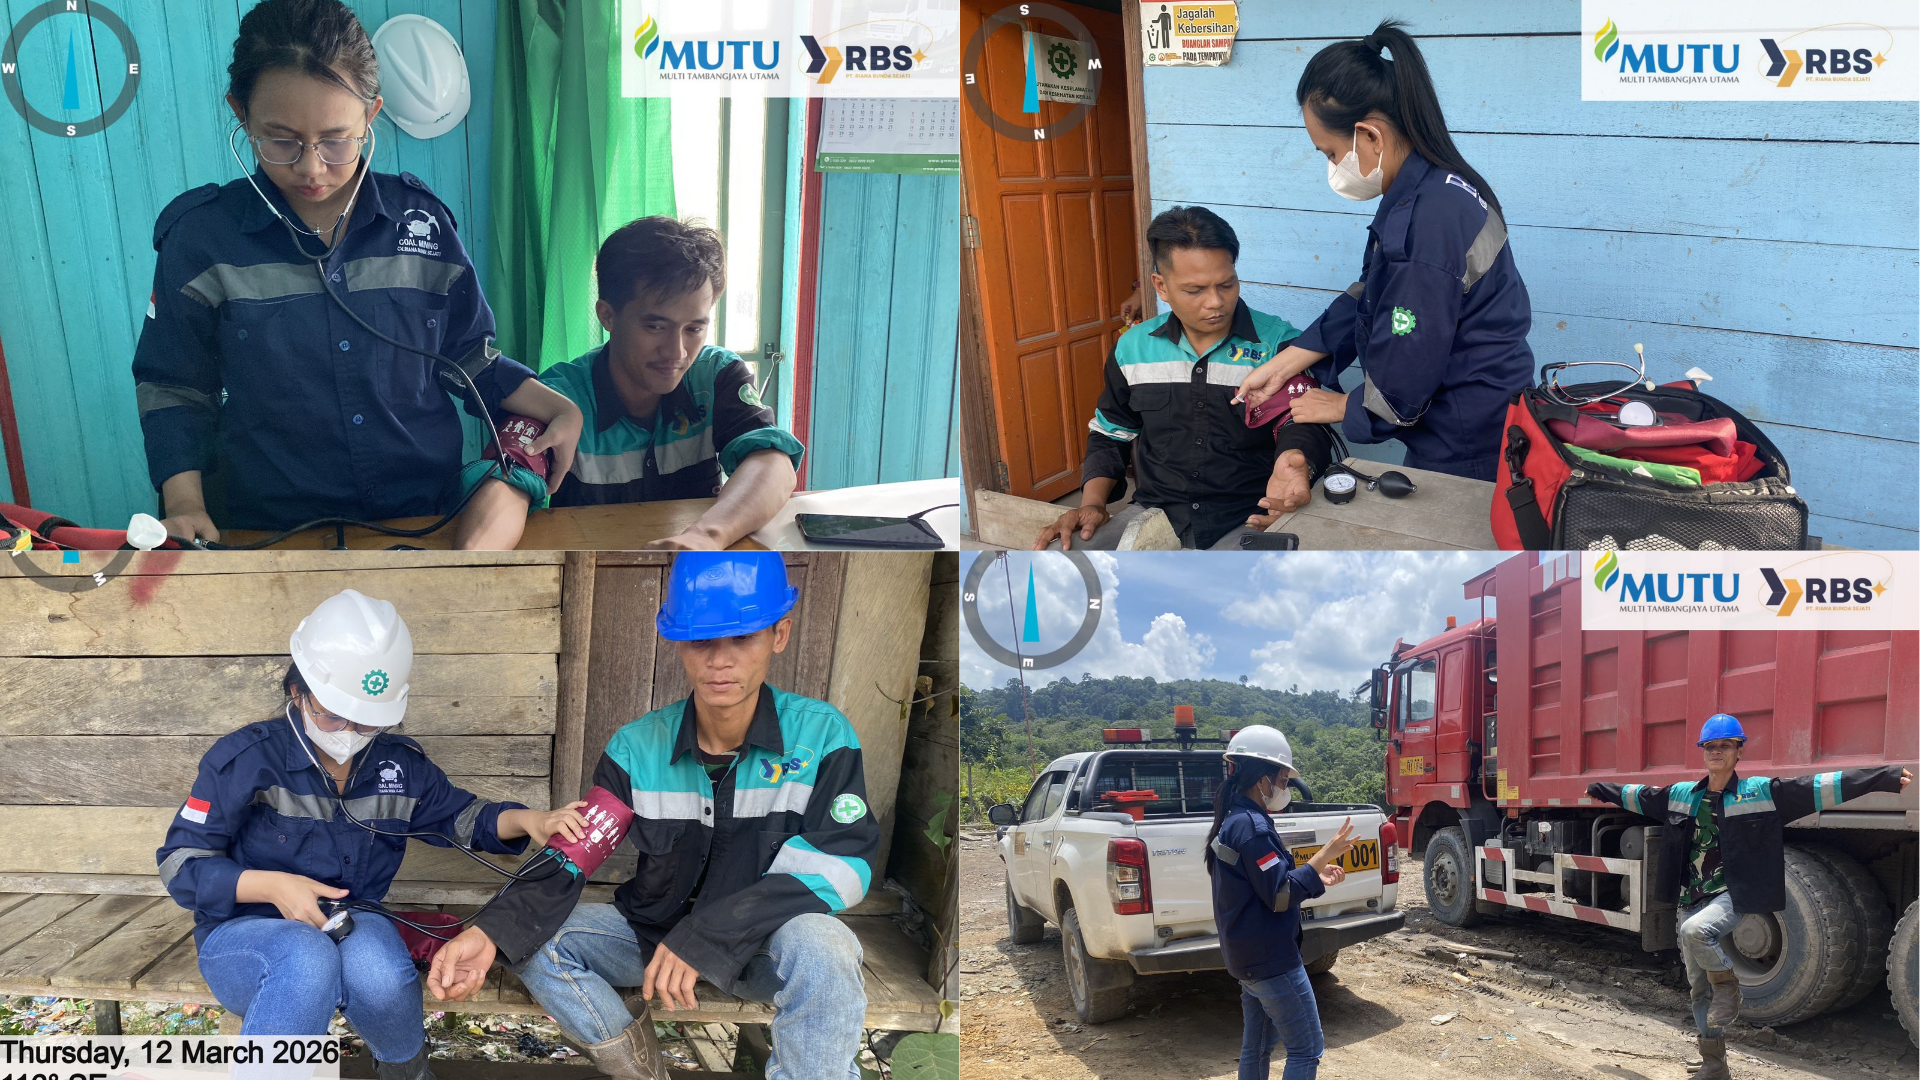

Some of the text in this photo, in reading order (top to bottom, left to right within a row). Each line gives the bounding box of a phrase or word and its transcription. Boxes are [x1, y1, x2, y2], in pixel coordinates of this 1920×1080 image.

[1176, 8, 1215, 20] Jagalah
[1178, 22, 1234, 34] Kebersihan
[1182, 39, 1232, 48] BUANGLAH SAMPA
[1182, 52, 1197, 62] PADA
[1300, 852, 1316, 861] MUT
[1350, 843, 1377, 868] 001
